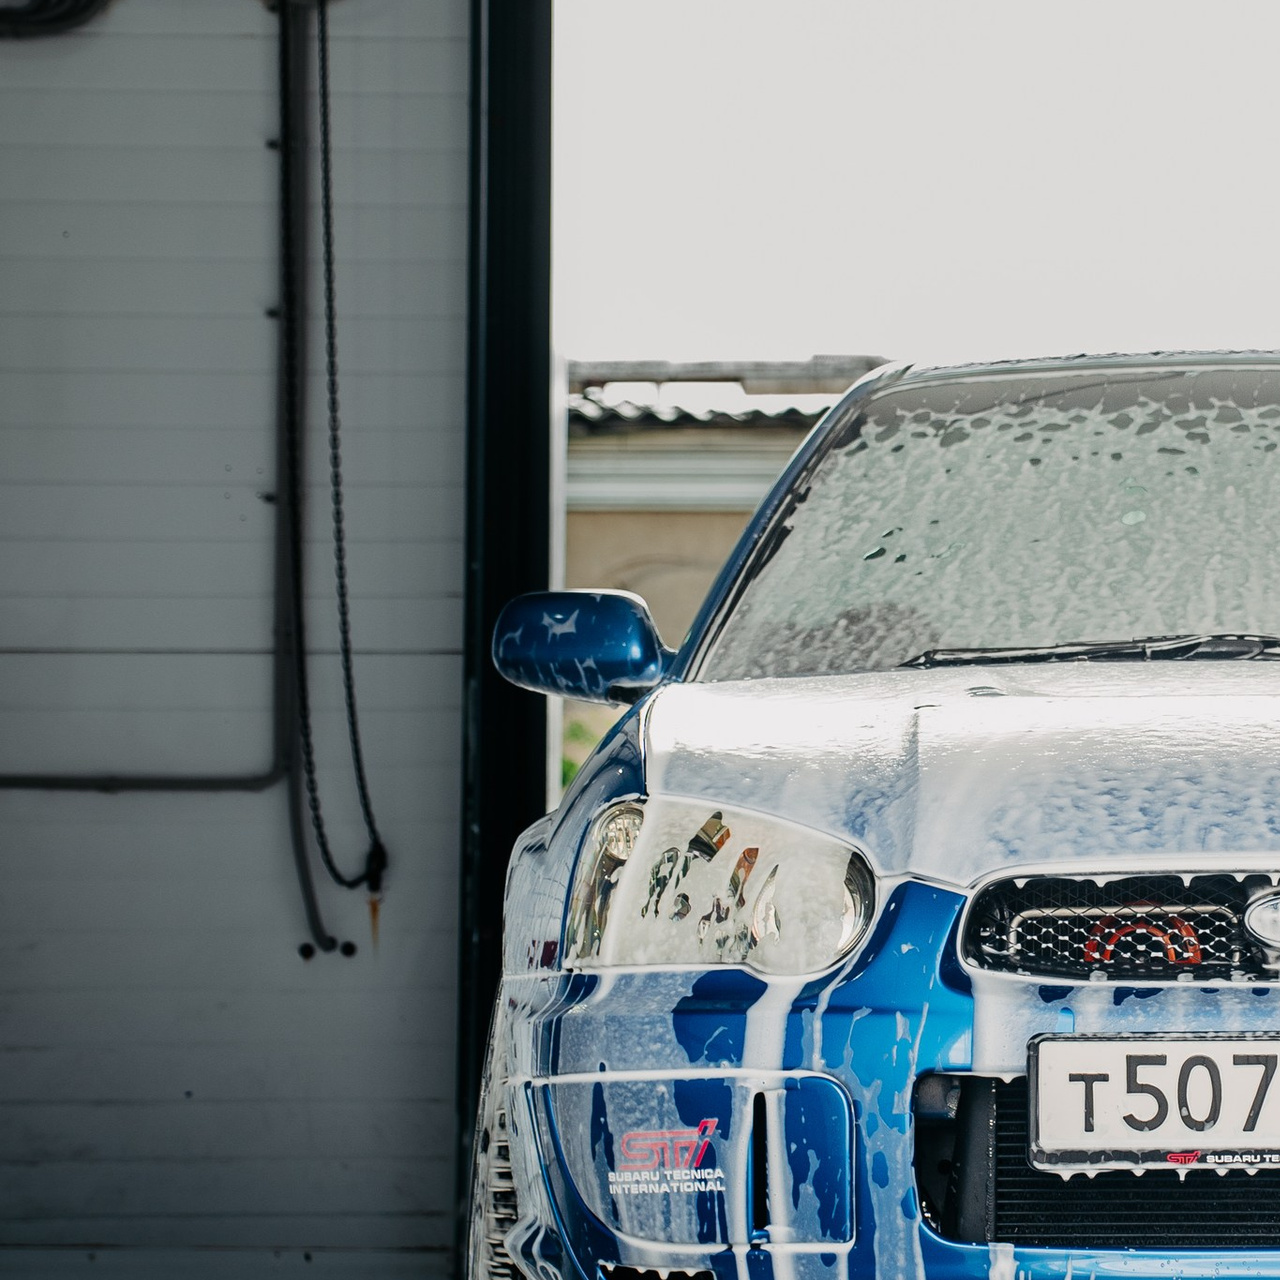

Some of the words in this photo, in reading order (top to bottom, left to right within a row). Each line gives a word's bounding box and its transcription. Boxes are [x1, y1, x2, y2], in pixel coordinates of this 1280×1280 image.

[1206, 1153, 1261, 1164] SUBARU
[608, 1171, 660, 1181] SUBARU
[664, 1168, 725, 1181] TECNICA
[609, 1181, 726, 1194] INTERNATIONAL
